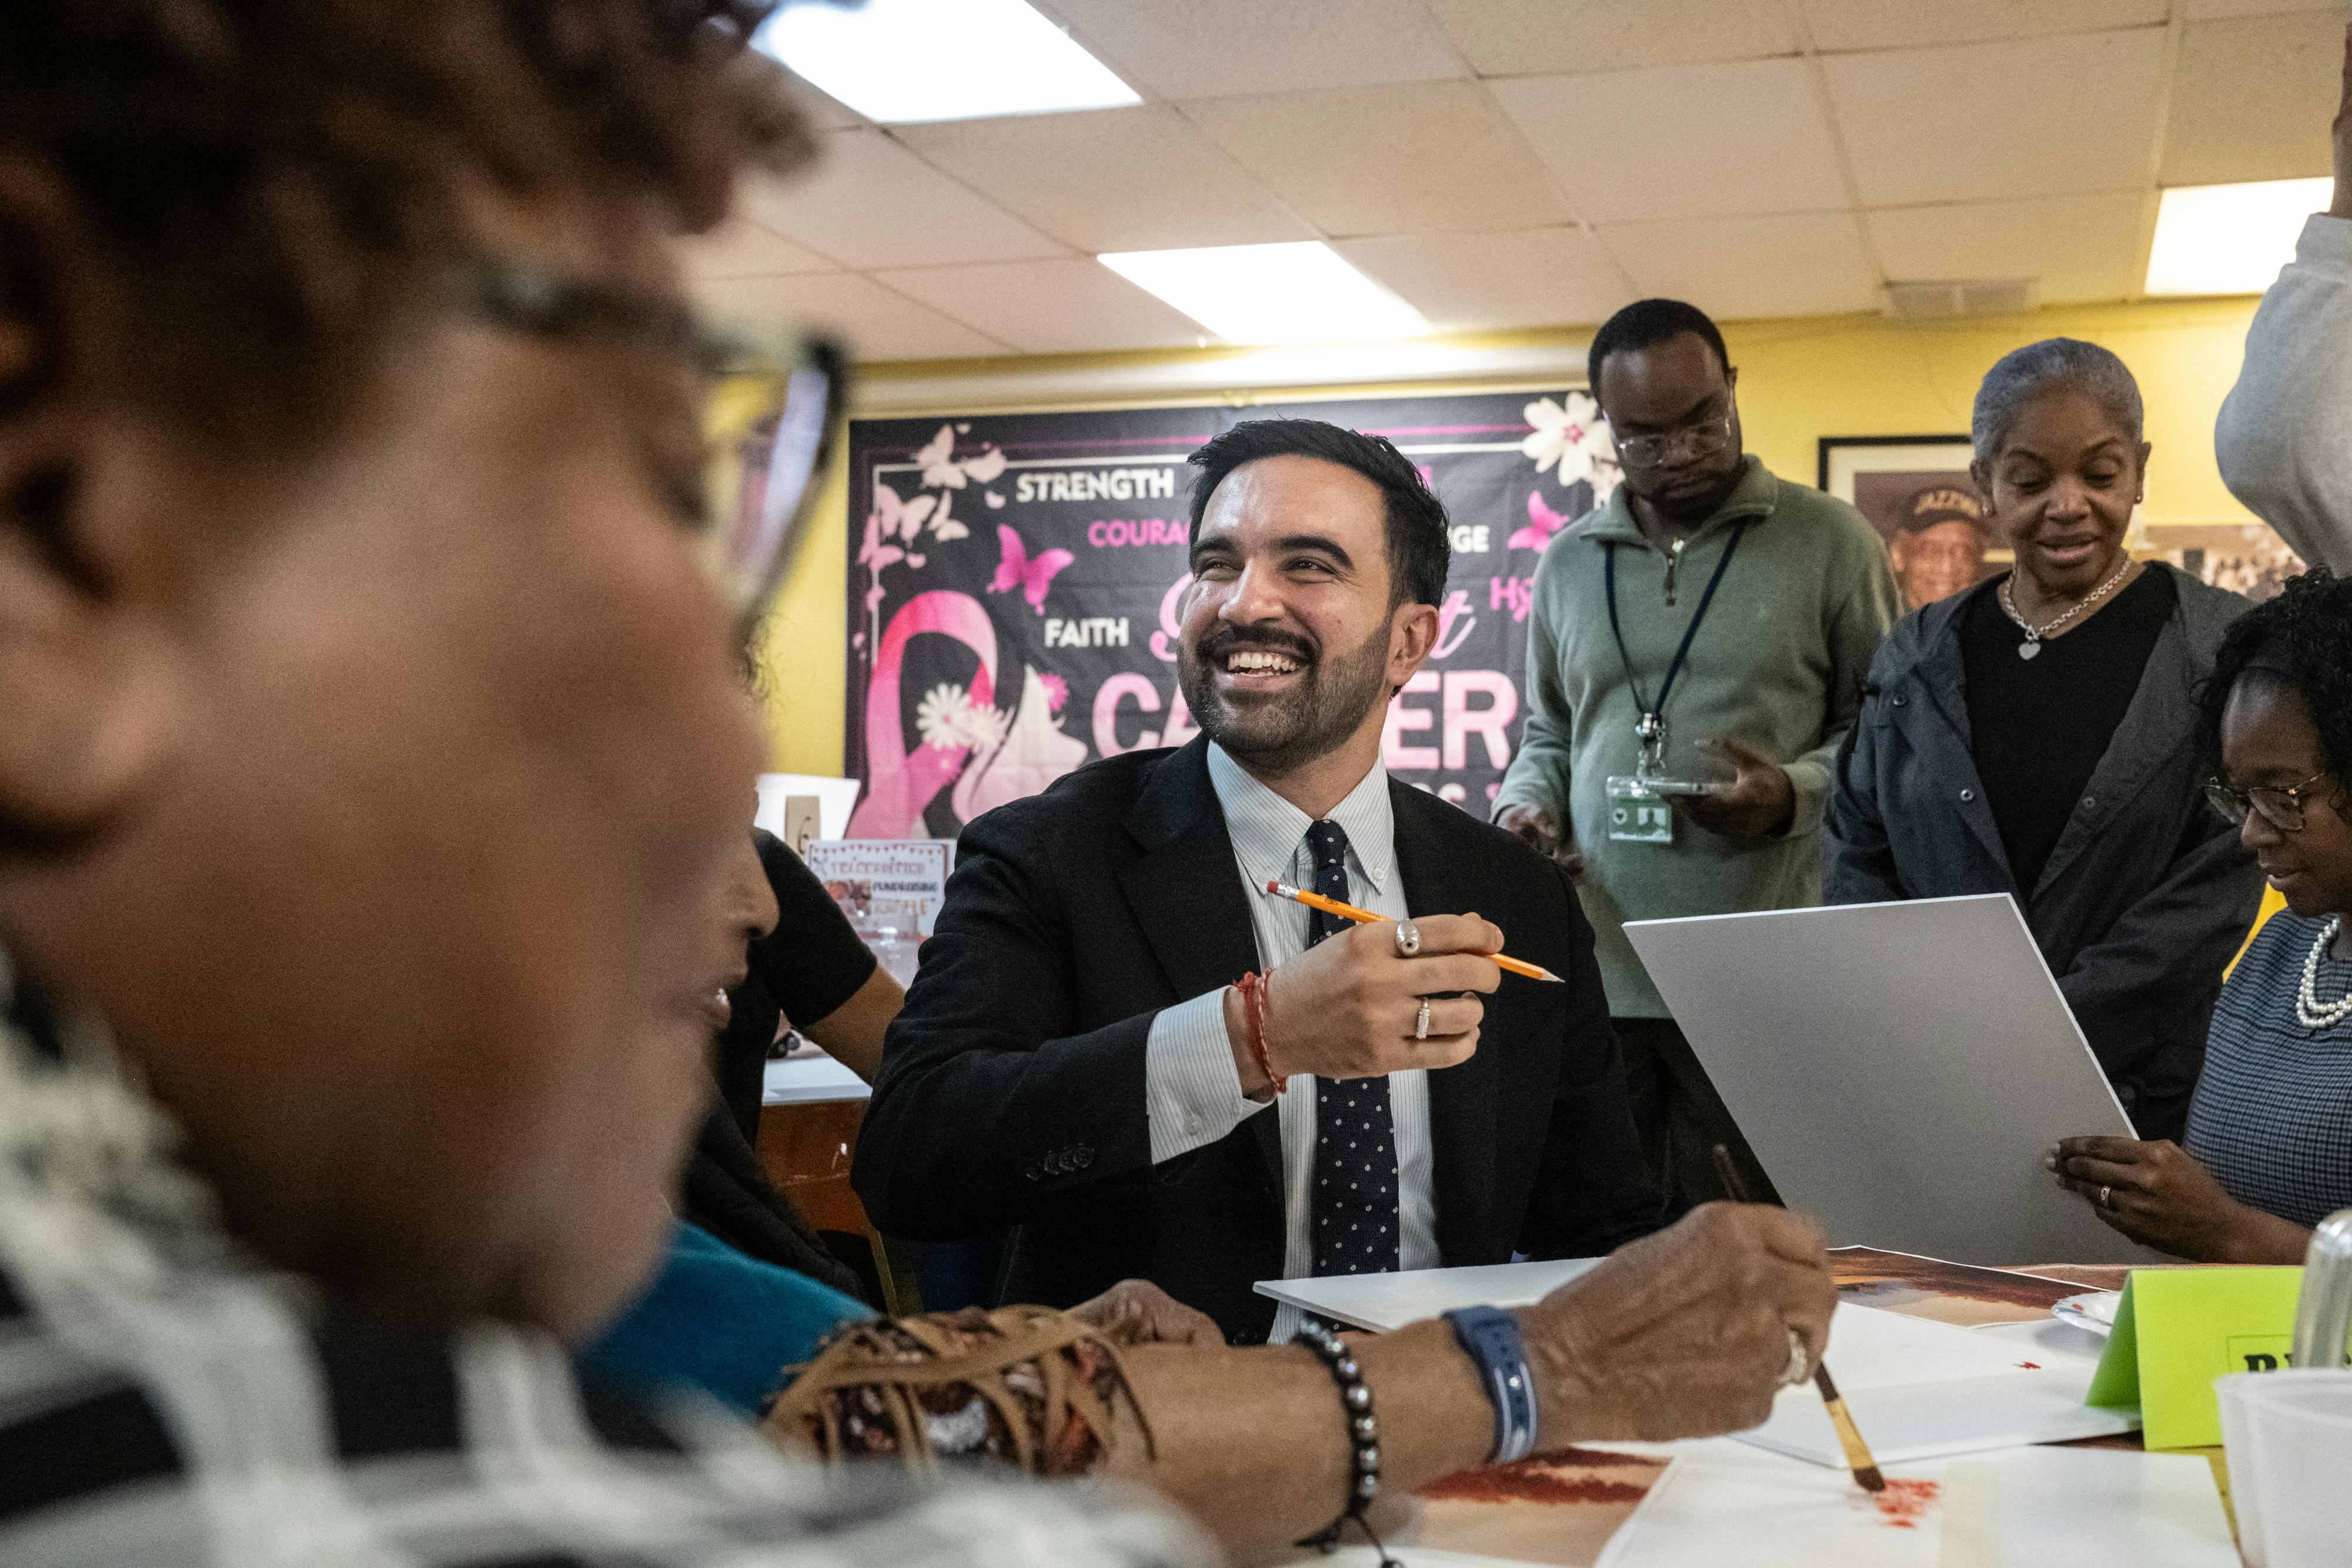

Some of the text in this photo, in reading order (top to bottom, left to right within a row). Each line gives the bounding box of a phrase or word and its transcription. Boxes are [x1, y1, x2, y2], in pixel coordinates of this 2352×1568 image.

[1016, 469, 1175, 502] STRENGTH
[1089, 519, 1190, 547] COURA
[1044, 617, 1129, 647] FAITH
